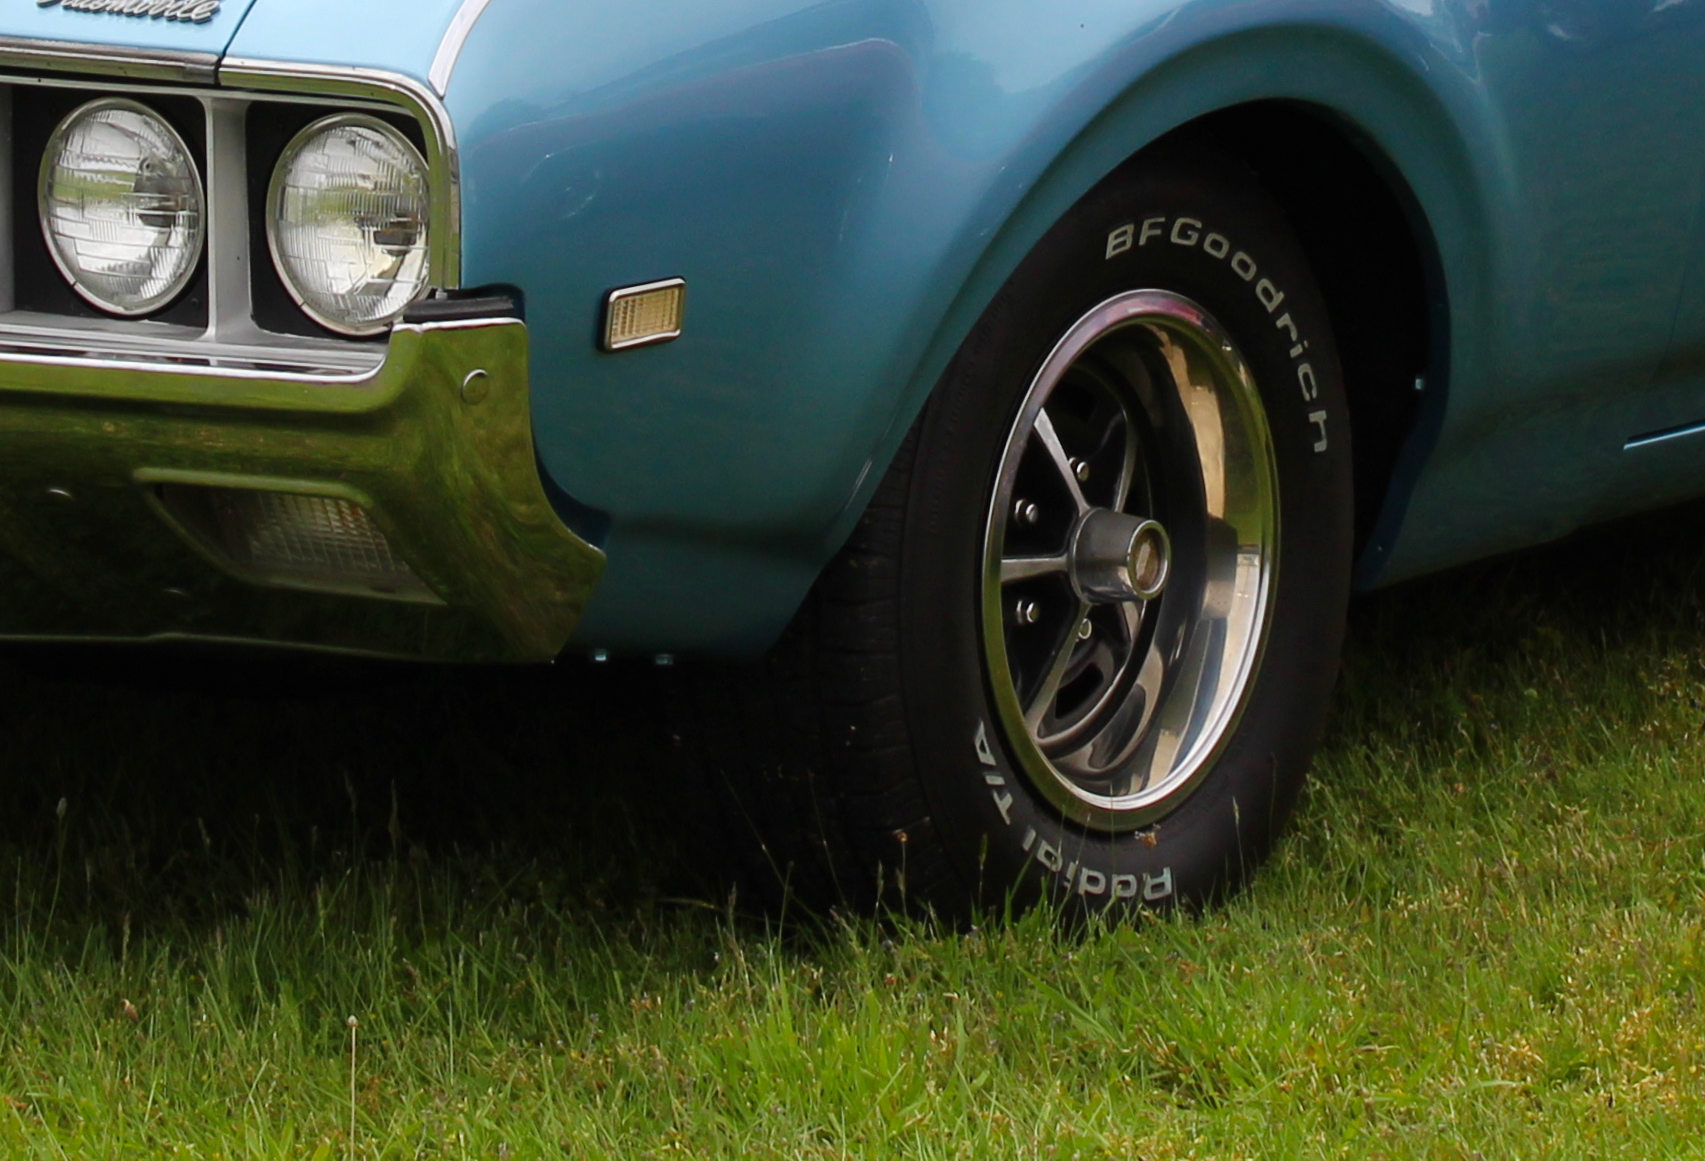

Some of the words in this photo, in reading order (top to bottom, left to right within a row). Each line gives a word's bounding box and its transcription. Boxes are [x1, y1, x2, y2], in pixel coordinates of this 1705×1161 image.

[1105, 217, 1327, 453] BFGoodrich
[975, 720, 1013, 826] T/A
[1022, 828, 1173, 901] Radial
